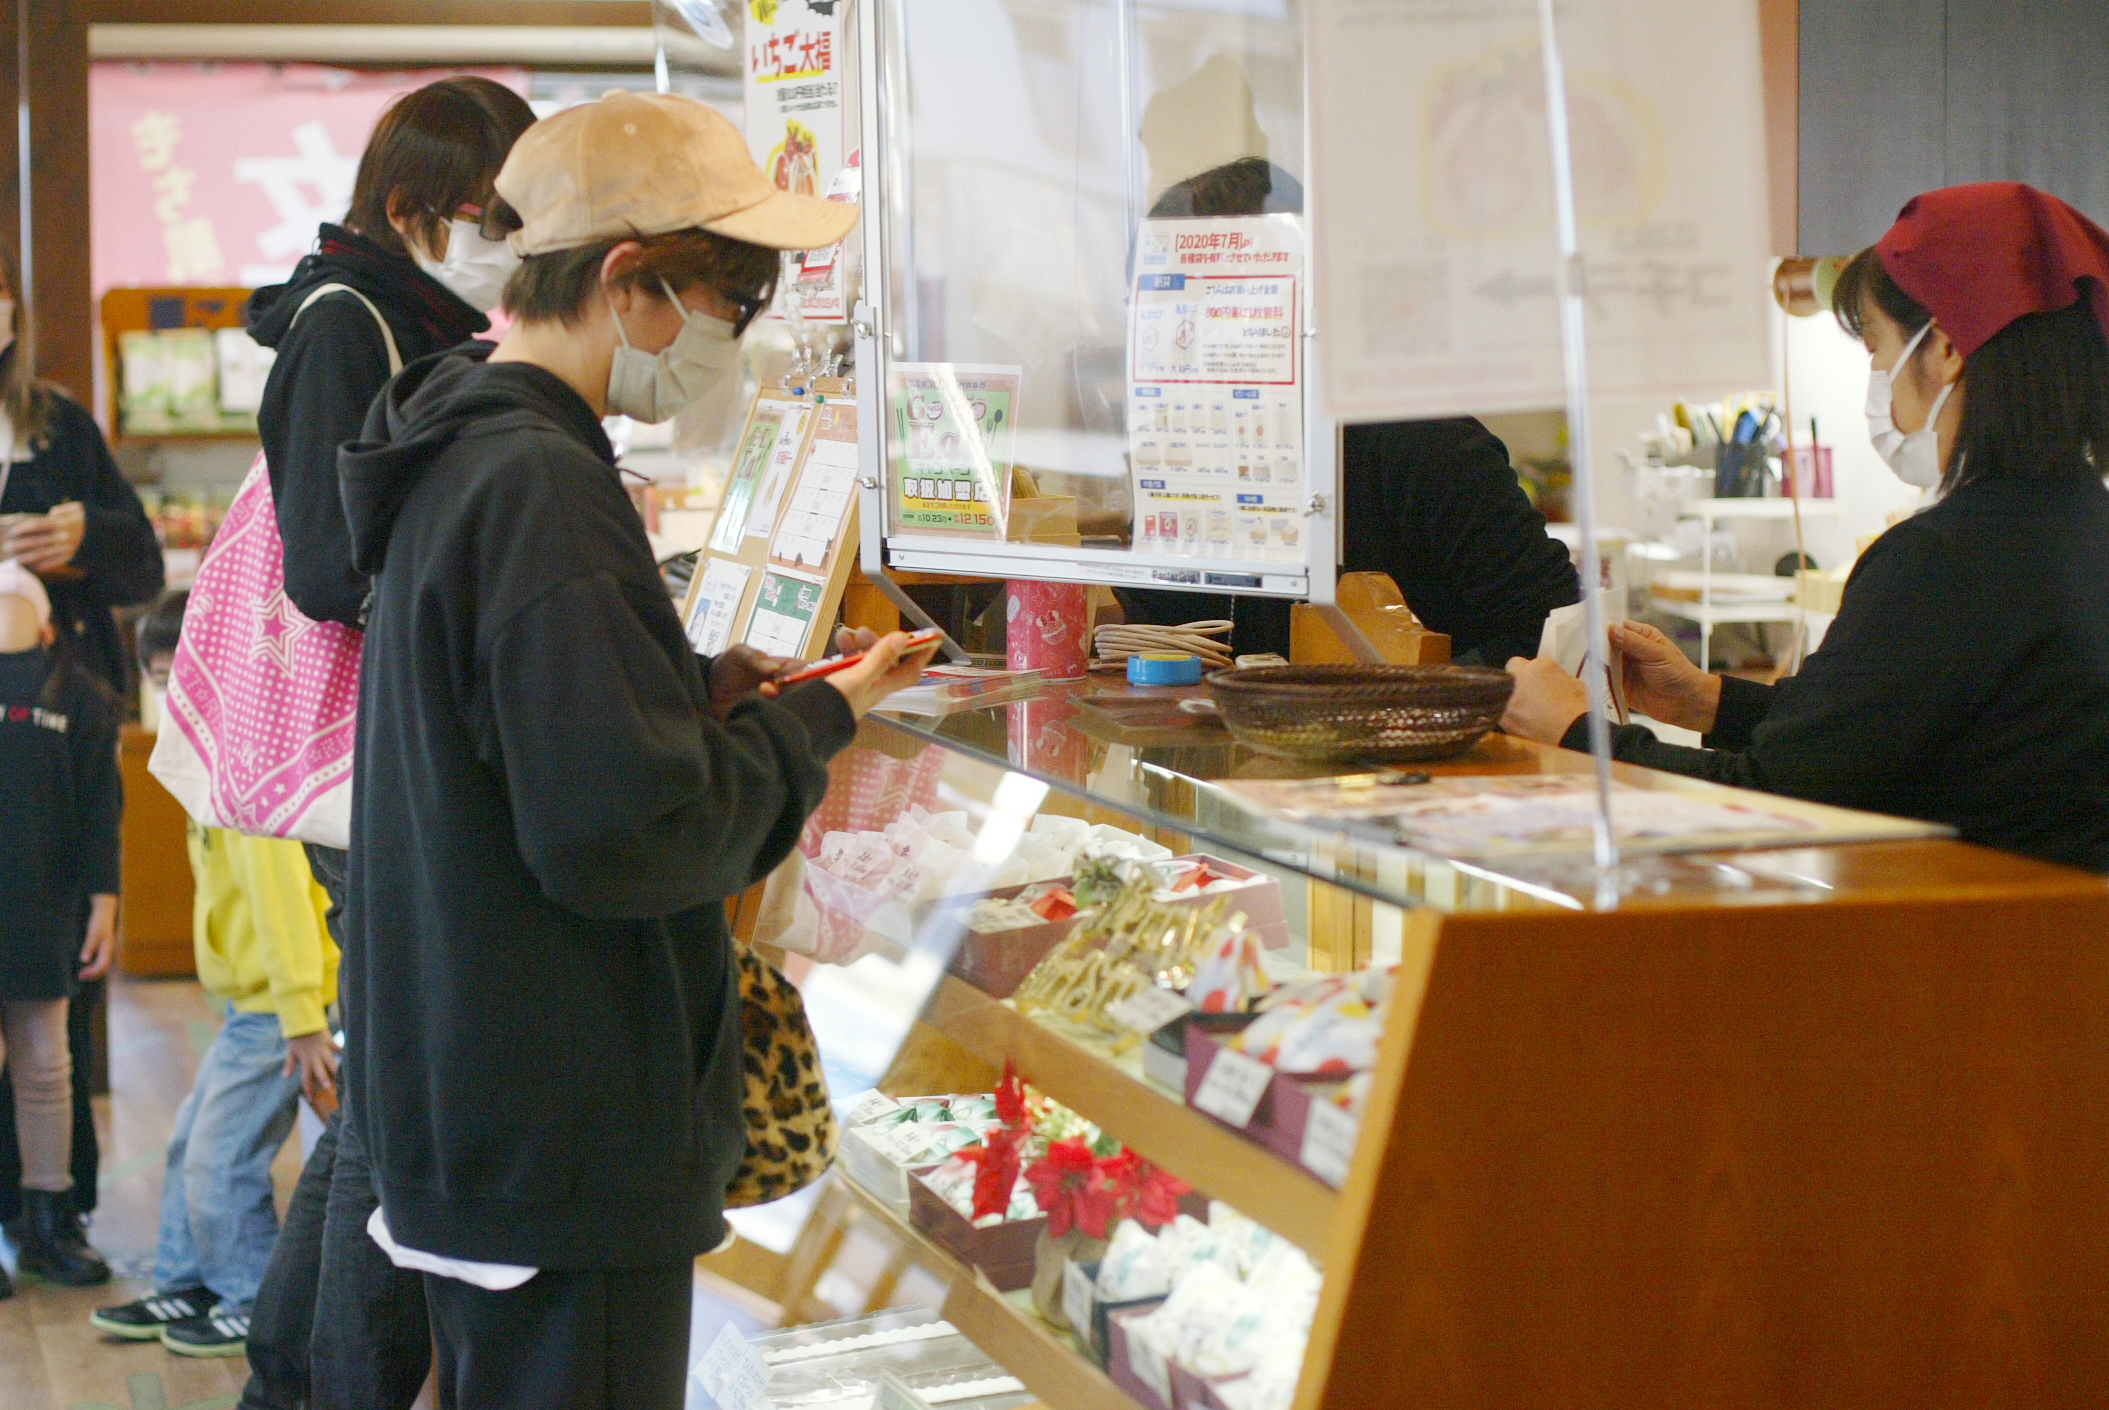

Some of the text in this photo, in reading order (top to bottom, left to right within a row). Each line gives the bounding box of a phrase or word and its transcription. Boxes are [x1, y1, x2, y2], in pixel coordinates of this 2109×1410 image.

[752, 29, 831, 78] いちご大福
[903, 477, 991, 502] 取扱加盟店
